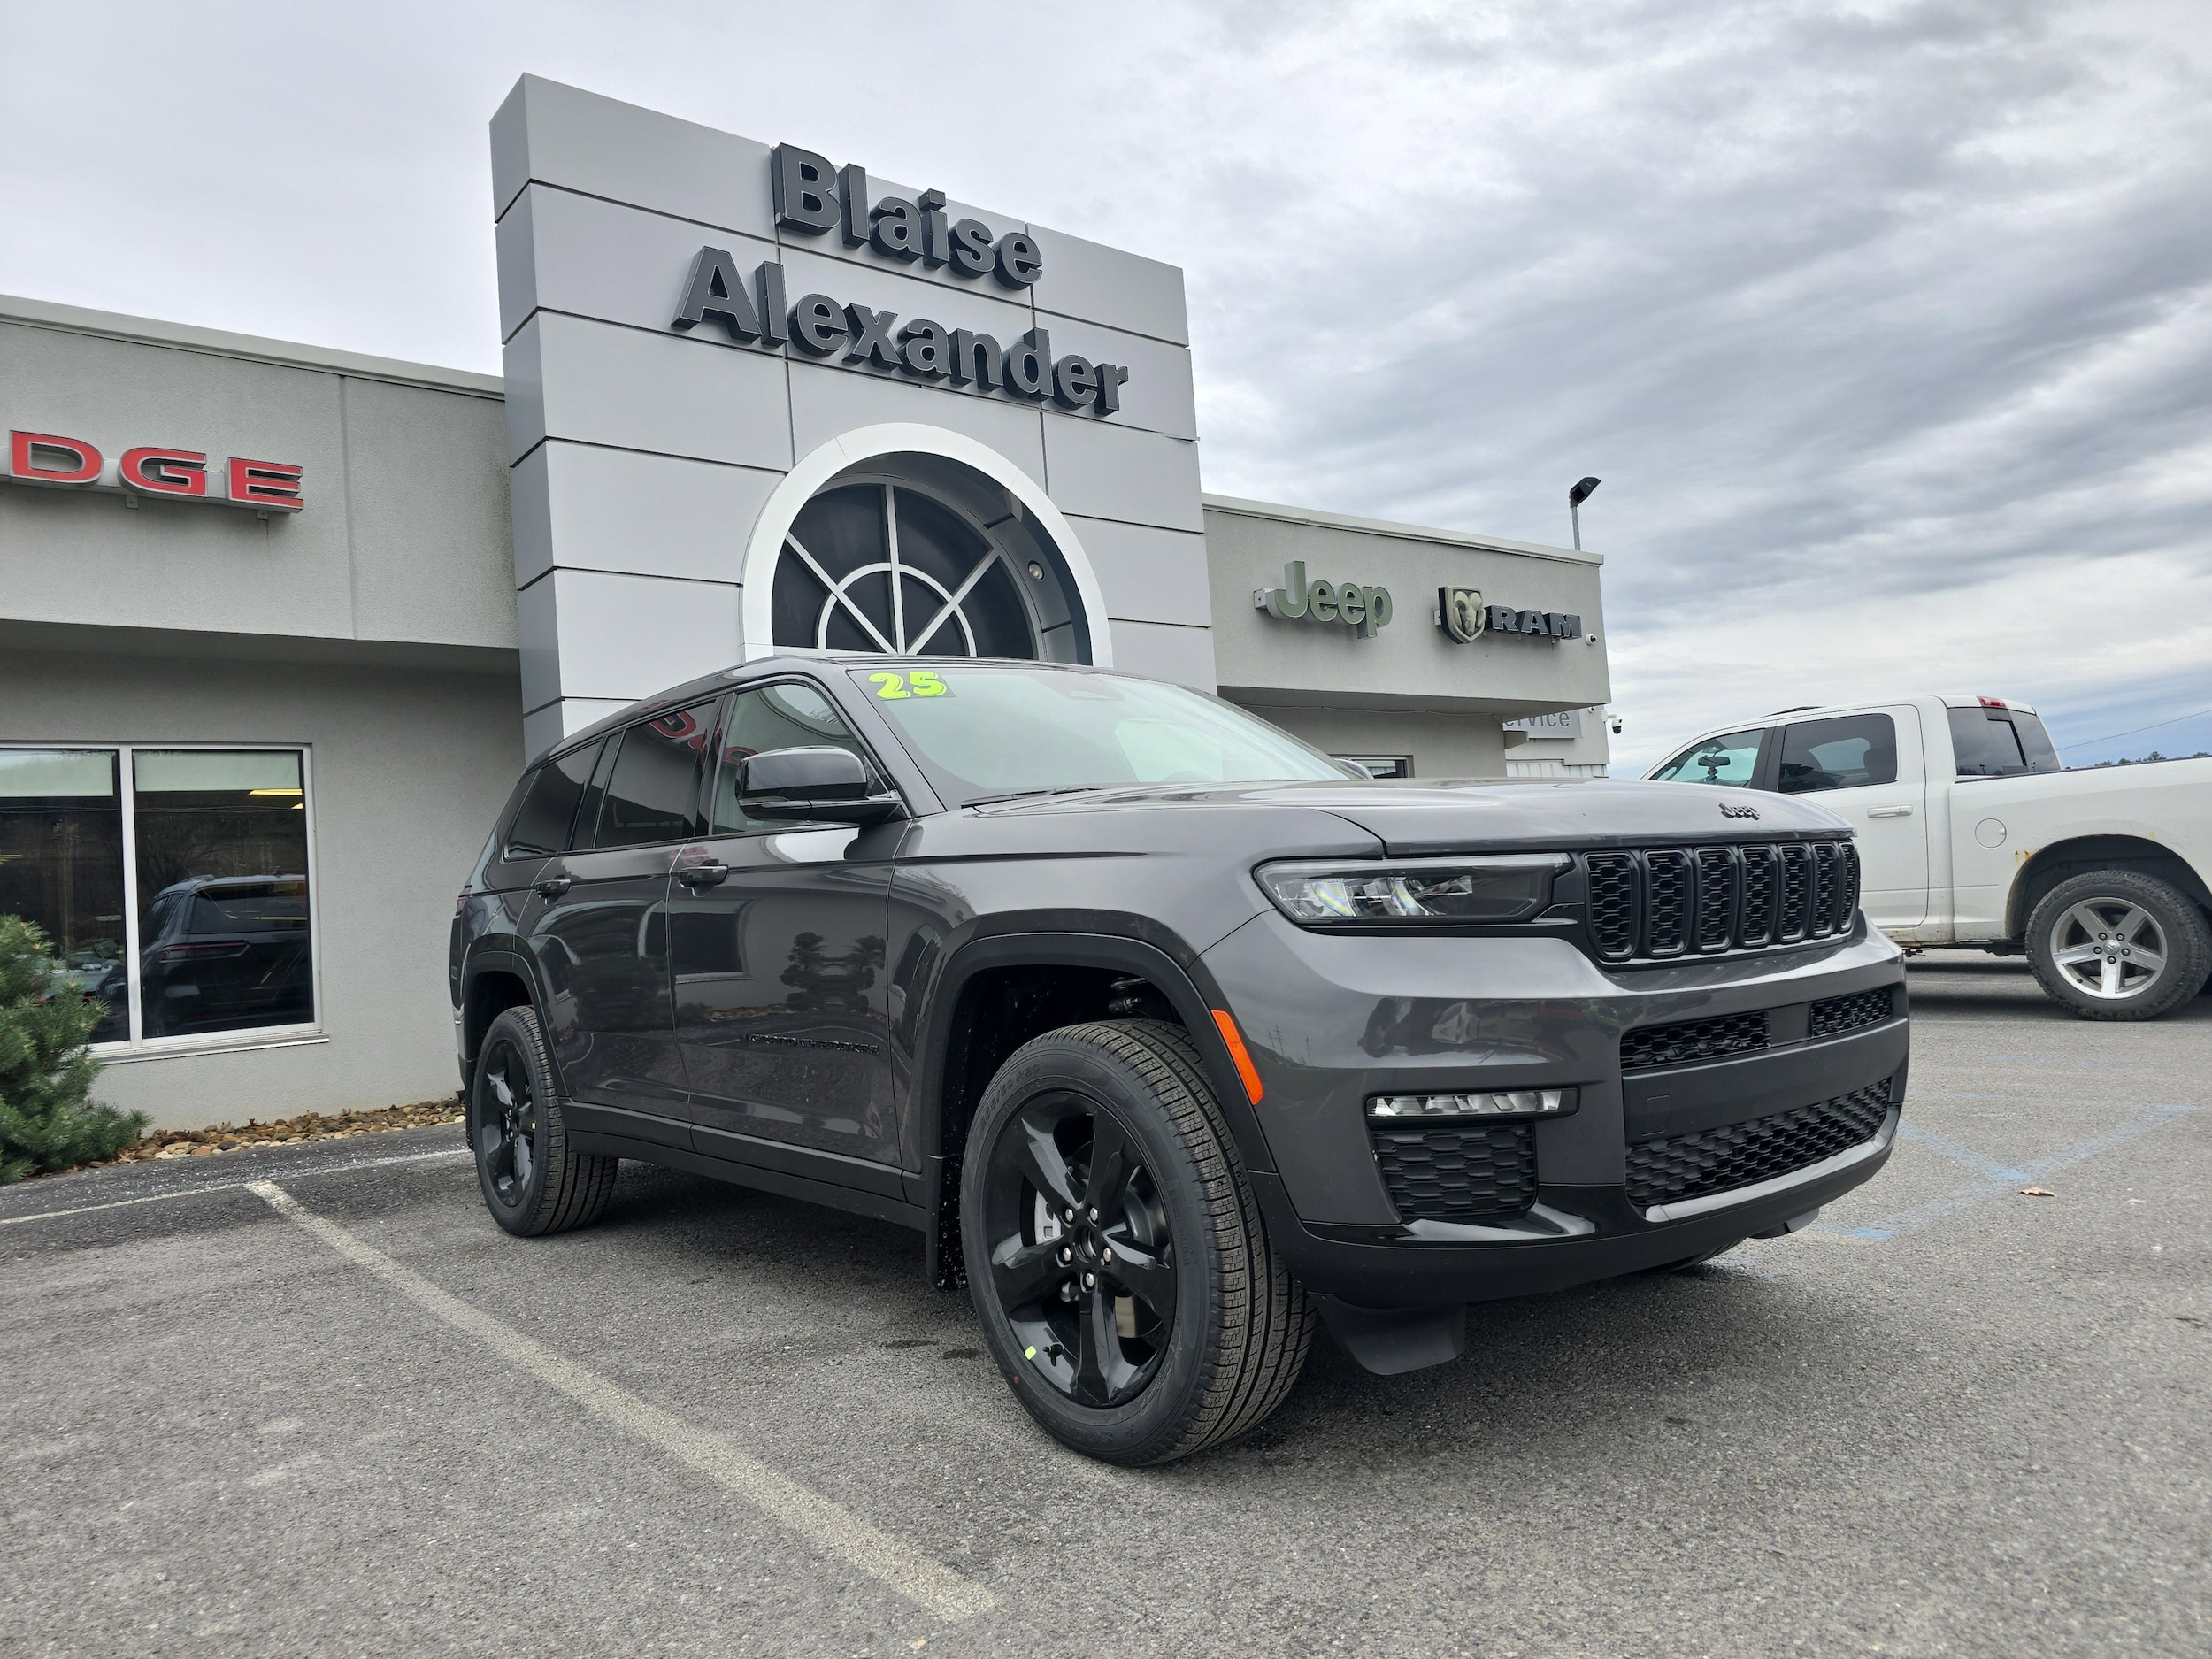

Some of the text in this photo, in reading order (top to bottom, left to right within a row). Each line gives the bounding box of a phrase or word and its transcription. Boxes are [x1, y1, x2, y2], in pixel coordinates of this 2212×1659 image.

[772, 142, 1043, 290] Blaise
[672, 246, 1128, 416] Alexander
[1264, 560, 1393, 639] Jeep
[1485, 604, 1582, 640] RAM
[869, 672, 947, 700] 25
[1718, 803, 1760, 820] Jeep
